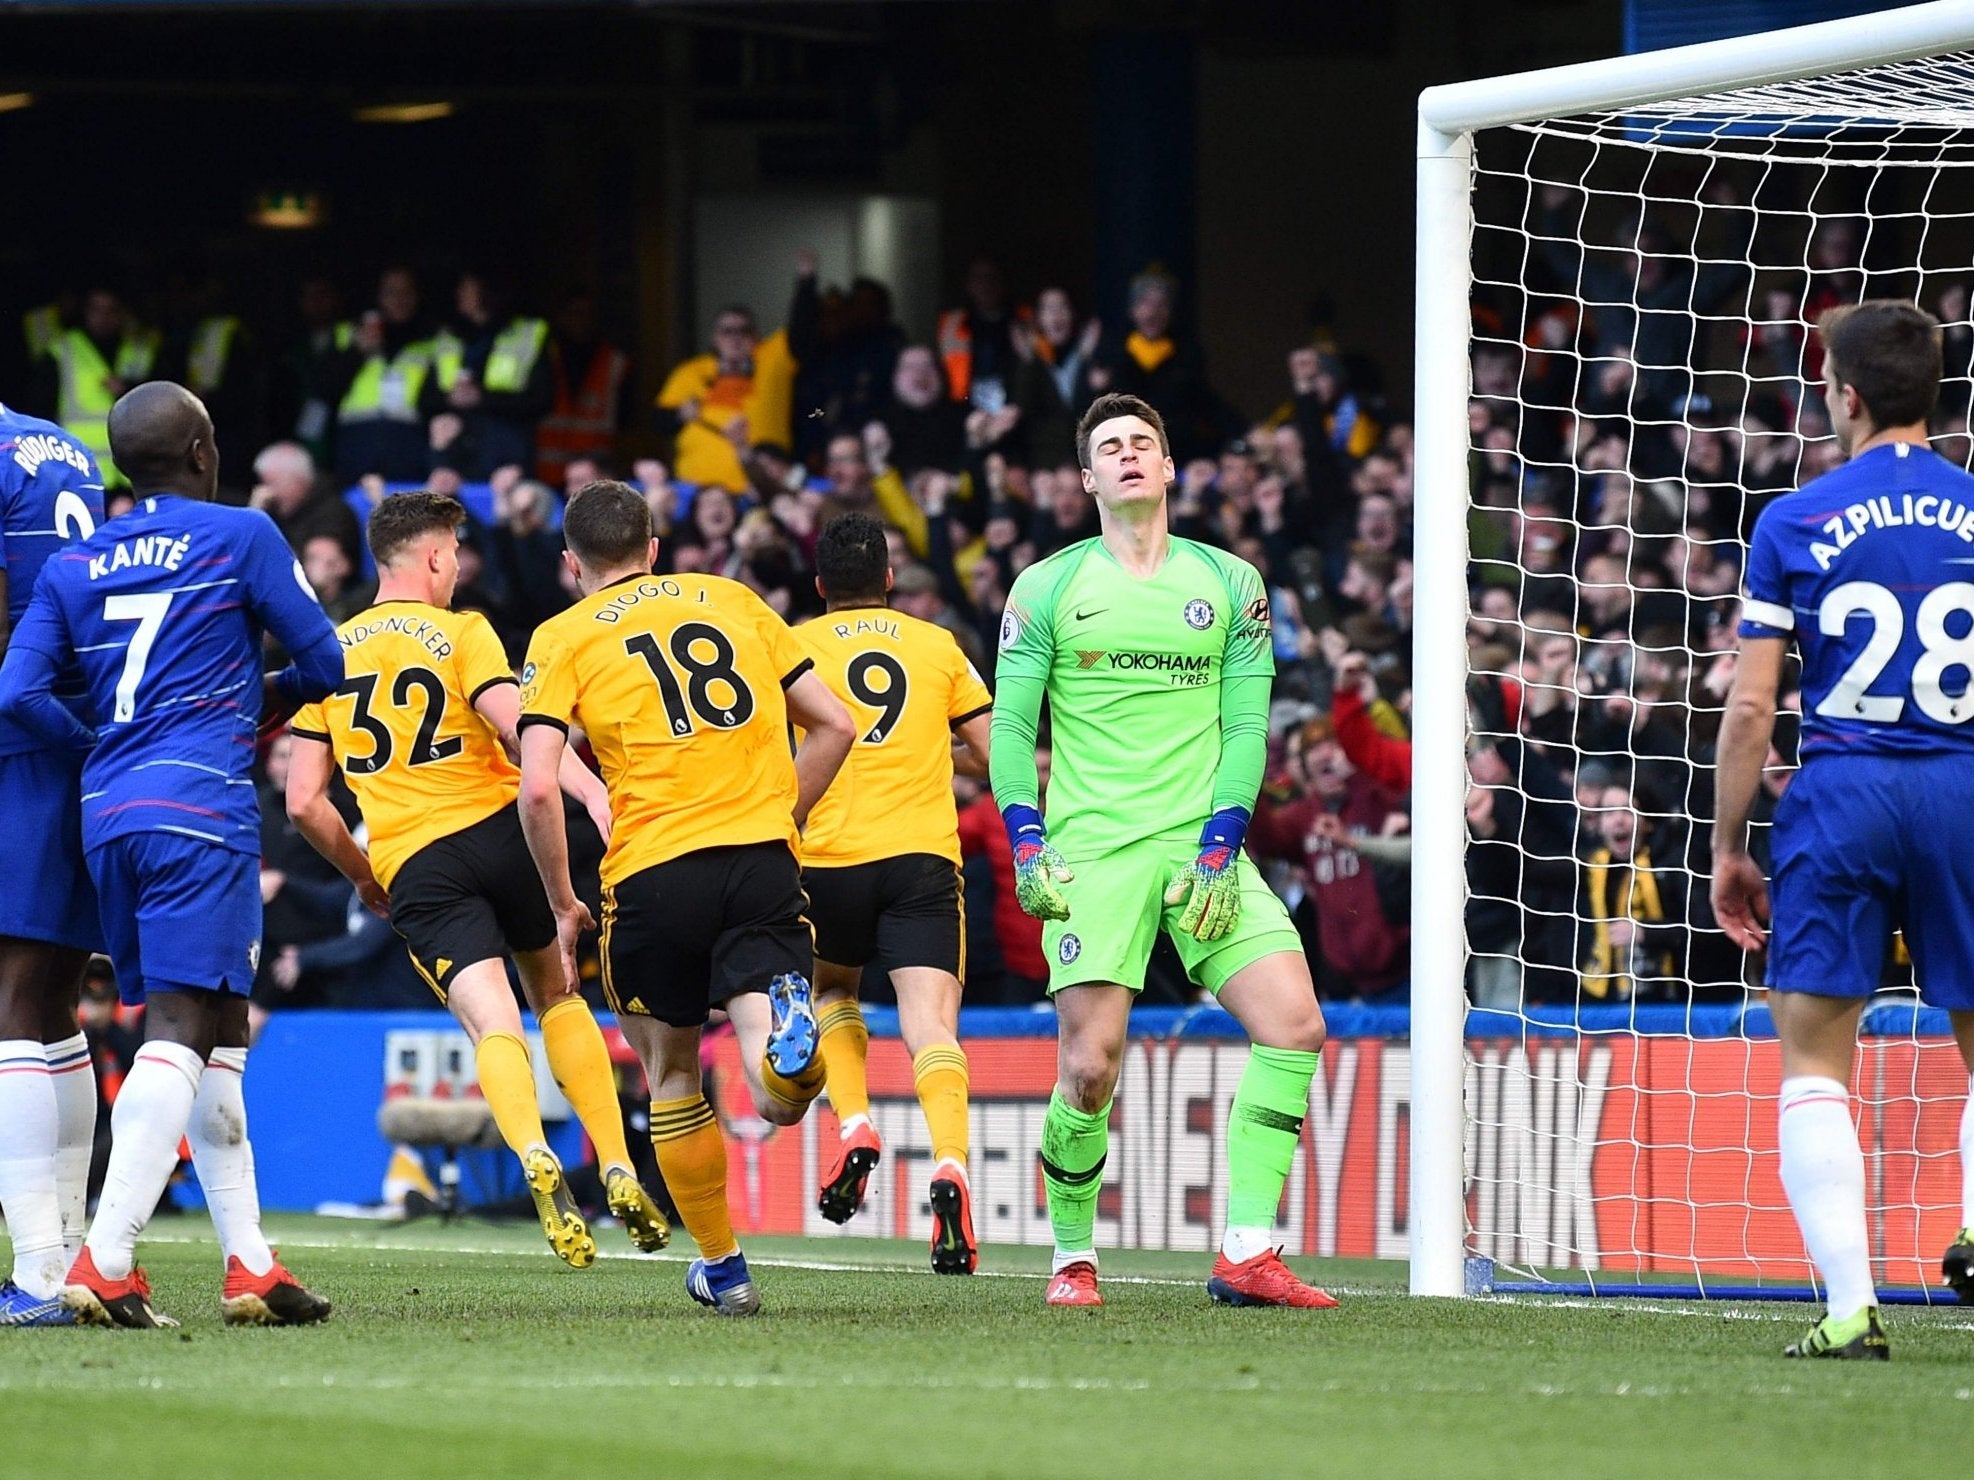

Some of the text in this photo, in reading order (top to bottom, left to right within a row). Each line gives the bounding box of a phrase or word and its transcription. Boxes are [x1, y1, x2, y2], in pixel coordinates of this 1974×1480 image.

[14, 434, 90, 477] RÜDIGER
[89, 534, 191, 580] KANTÉ
[595, 580, 680, 623] DIOGO
[834, 618, 900, 640] RAUL
[103, 593, 173, 723] 7
[1107, 653, 1211, 671] YOKOHAMA
[1815, 581, 1974, 724] 28
[625, 622, 754, 737] 18
[846, 651, 908, 743] 9
[1170, 672, 1210, 686] TYRES
[335, 667, 463, 774] 32
